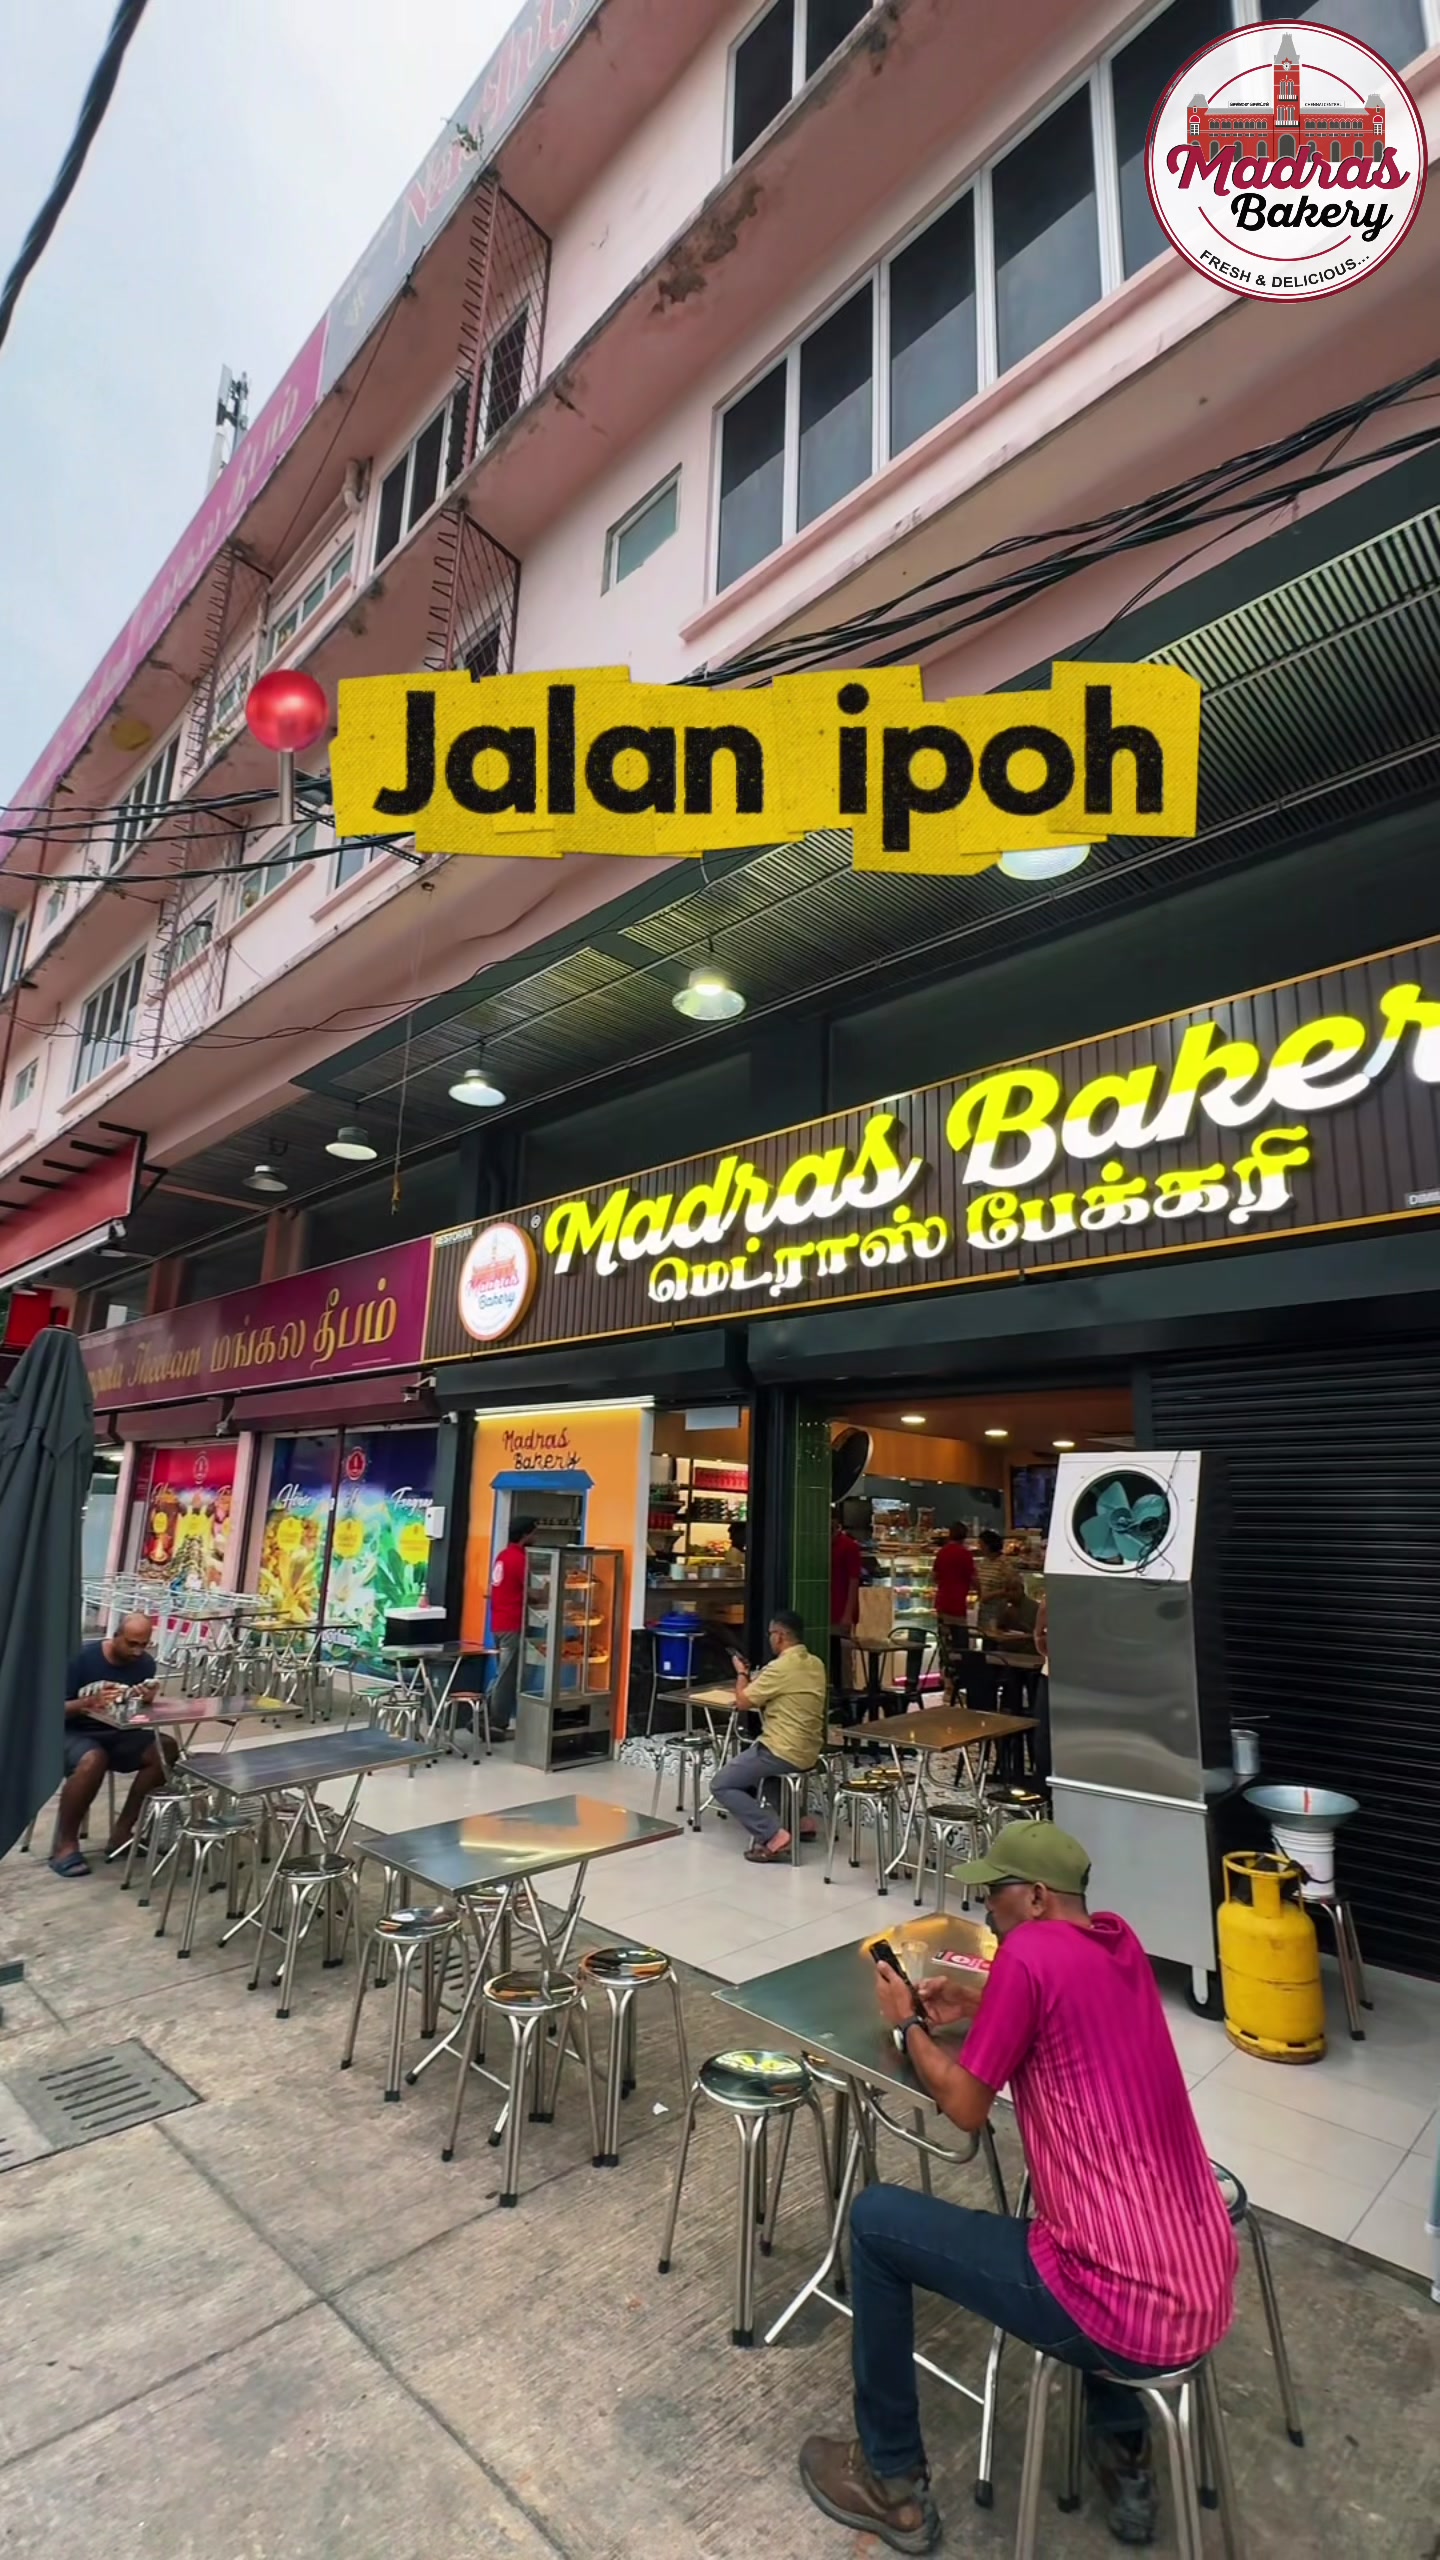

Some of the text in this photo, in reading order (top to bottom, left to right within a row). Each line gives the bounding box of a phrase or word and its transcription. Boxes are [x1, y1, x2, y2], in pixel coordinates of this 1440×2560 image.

[544, 1113, 923, 1277] Madras
[647, 1125, 1311, 1303] மெட்ராஸ் பேக்கரி
[209, 1277, 397, 1373] மங்கல தீபம்
[502, 1427, 571, 1453] Madras
